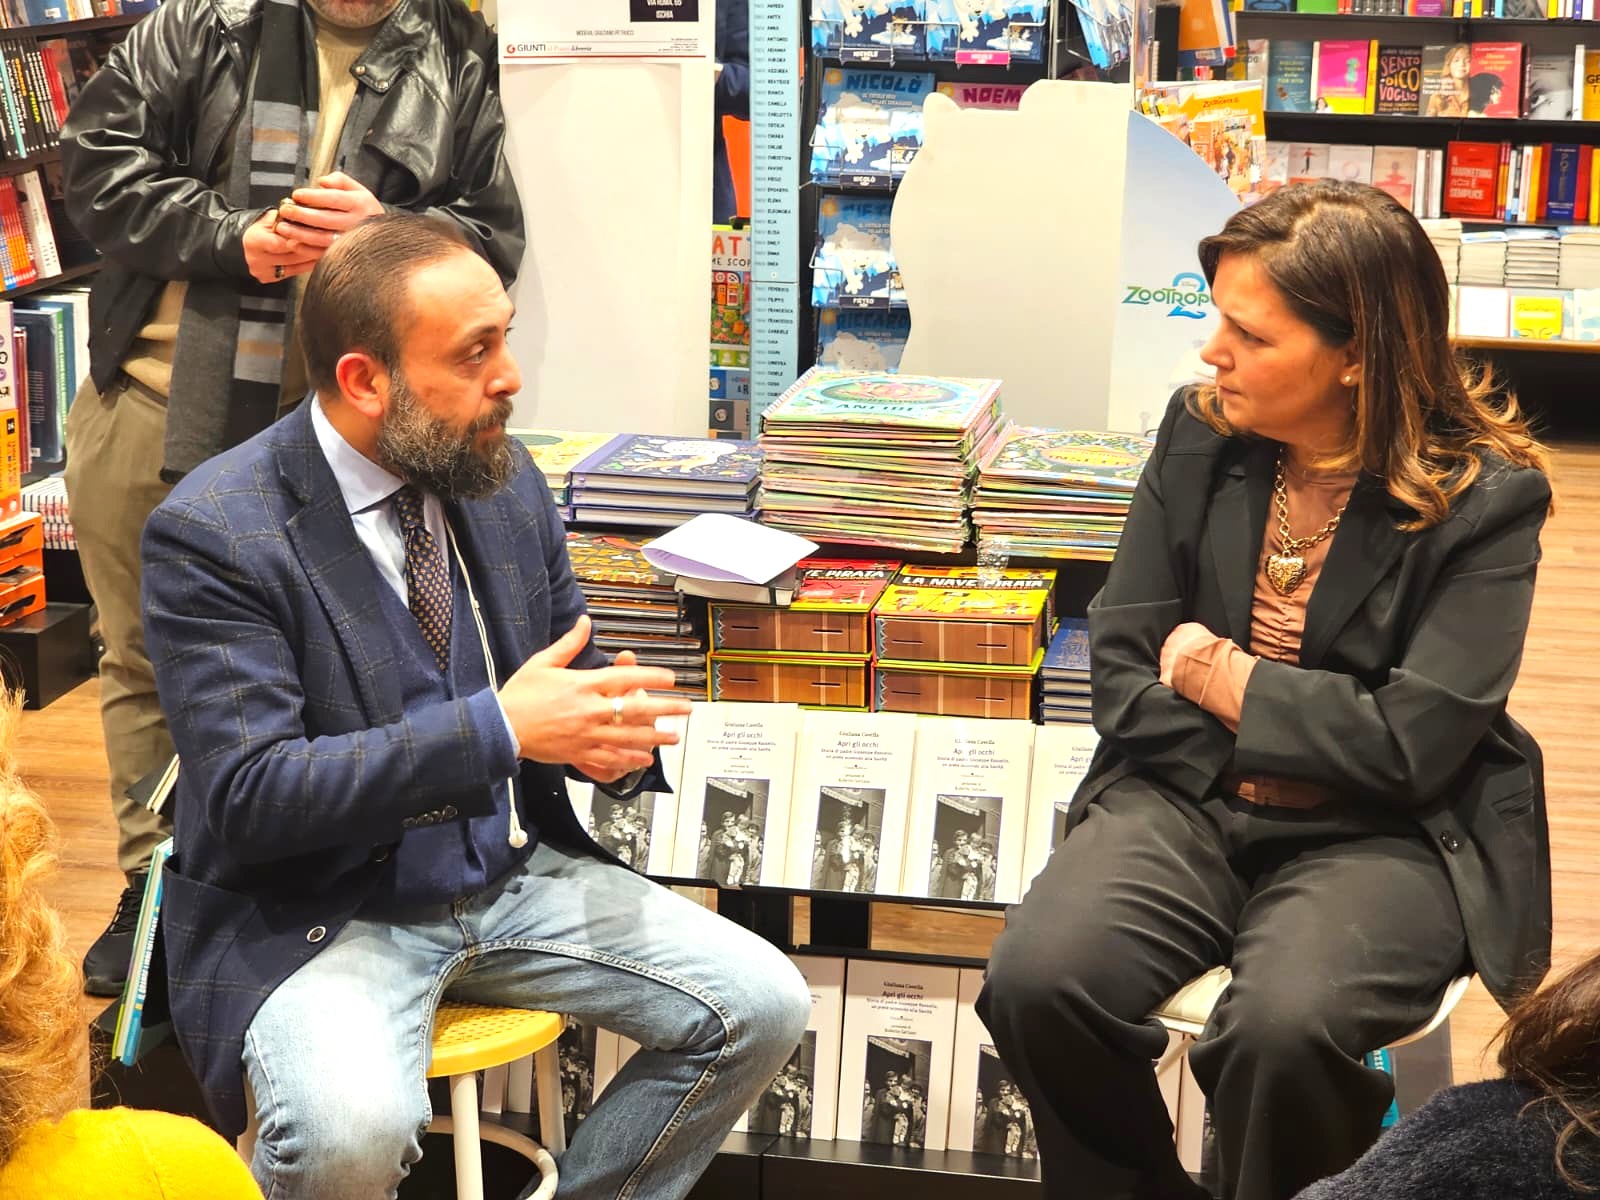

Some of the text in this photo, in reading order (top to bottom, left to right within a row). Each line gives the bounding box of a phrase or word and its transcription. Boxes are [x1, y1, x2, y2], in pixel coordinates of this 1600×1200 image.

[517, 44, 546, 52] GIUNTI
[1380, 55, 1421, 77] SENTO
[846, 73, 922, 93] NICOLÒ
[963, 87, 1021, 104] NOEM
[1379, 83, 1418, 102] VOGLIO
[1121, 286, 1211, 306] ZOOTROP
[825, 570, 884, 578] PIRATA
[902, 576, 925, 585] LA
[930, 577, 978, 587] NAVE
[737, 731, 746, 739] gli
[852, 740, 861, 748] gli
[882, 990, 896, 998] Apri
[896, 991, 906, 999] gli
